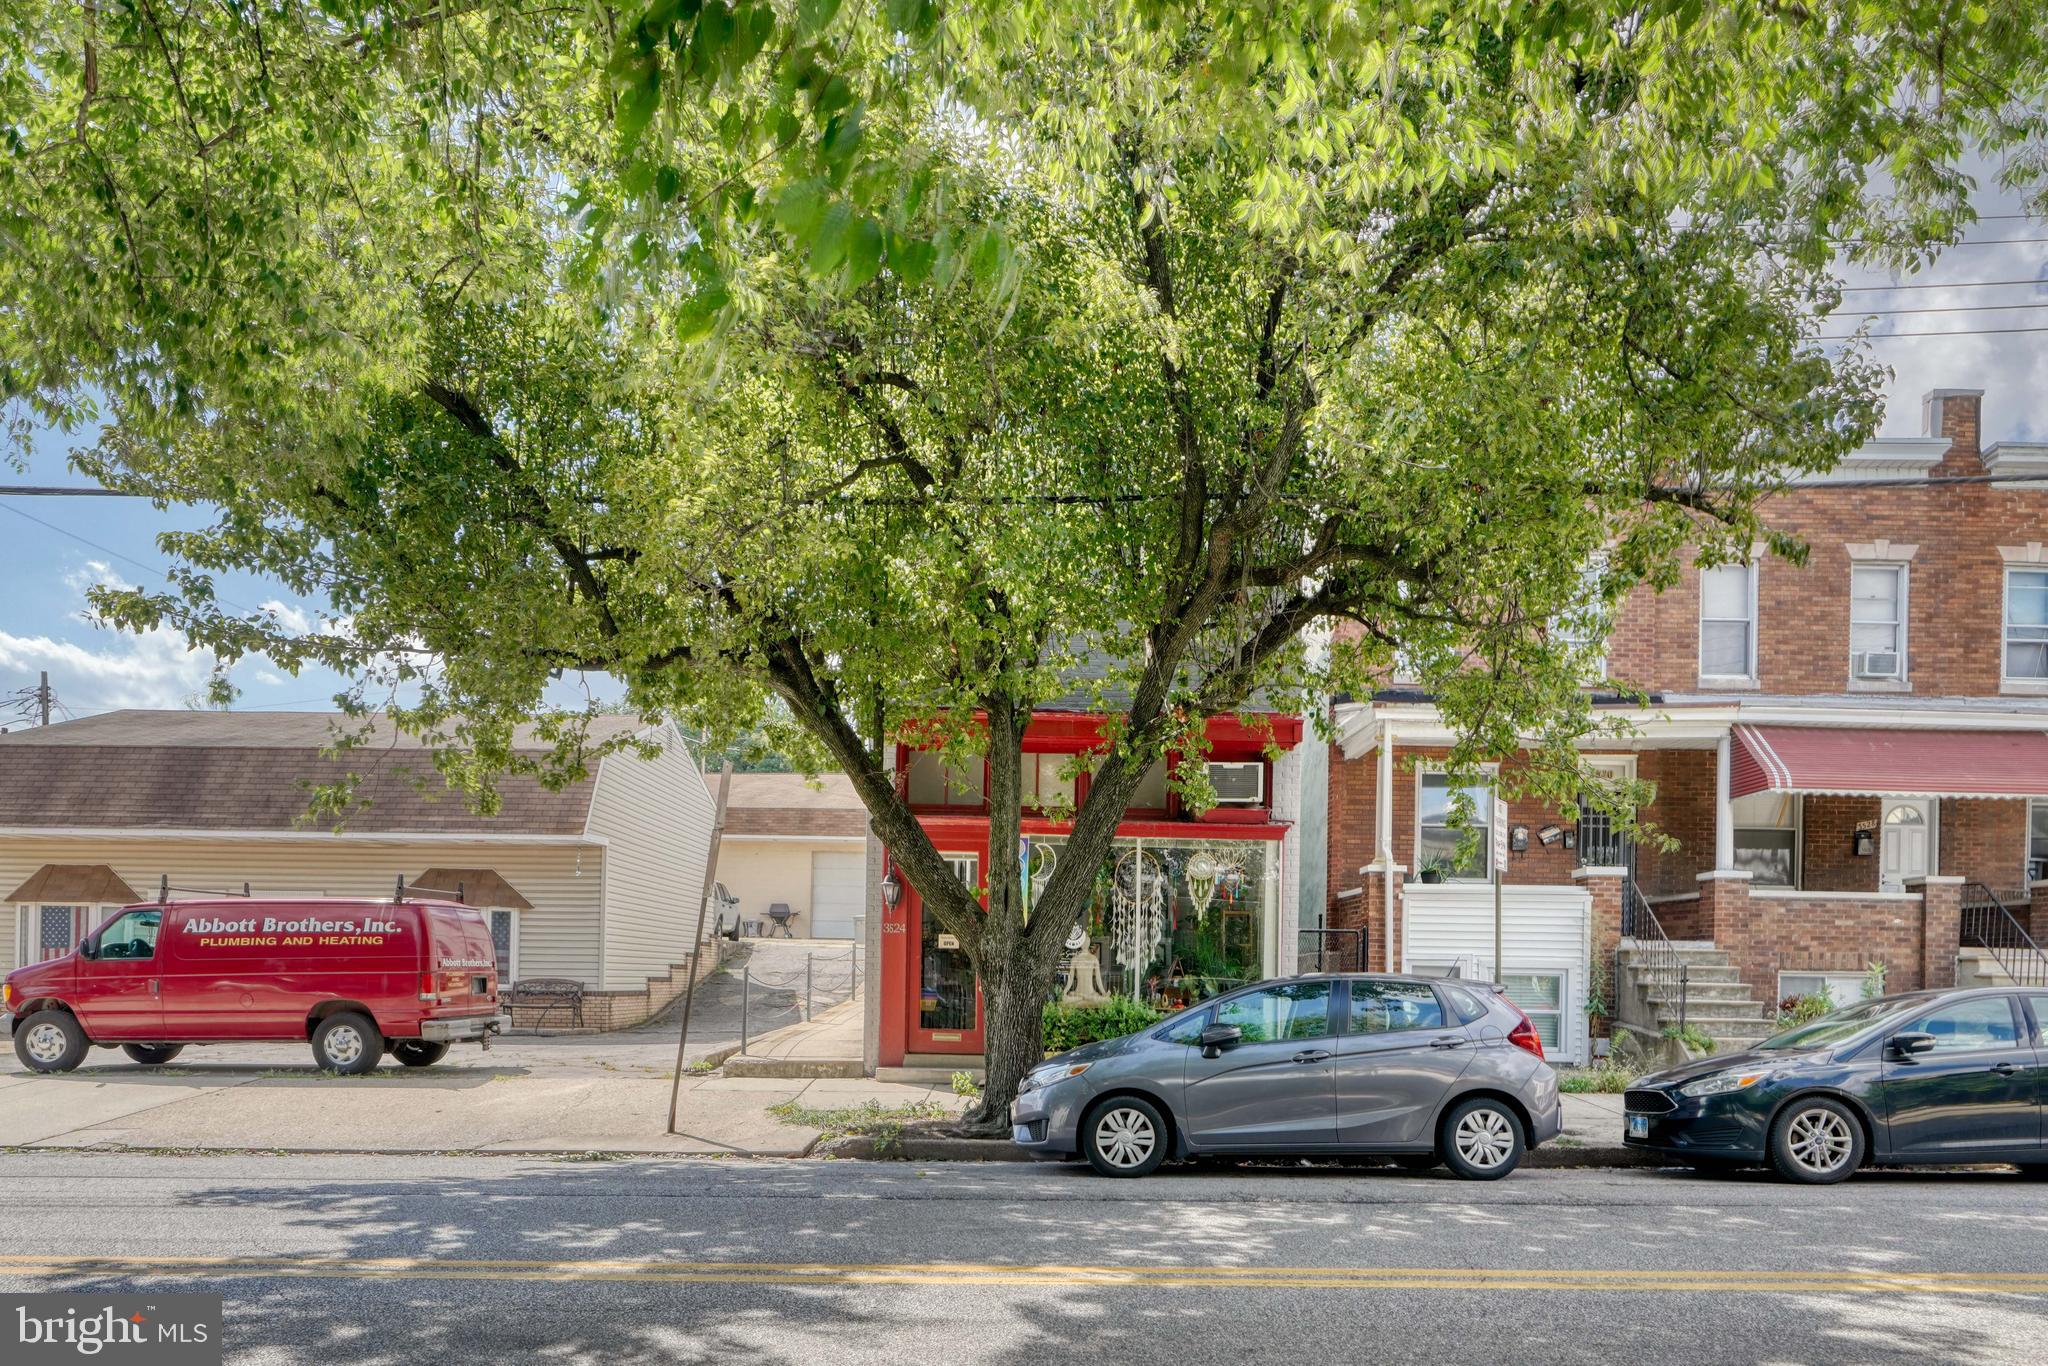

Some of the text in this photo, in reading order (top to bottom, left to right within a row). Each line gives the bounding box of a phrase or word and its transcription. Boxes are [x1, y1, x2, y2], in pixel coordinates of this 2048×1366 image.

[183, 918, 257, 933] Abbott
[883, 923, 906, 933] 3524
[200, 936, 384, 946] PLUMBING AND HEATING
